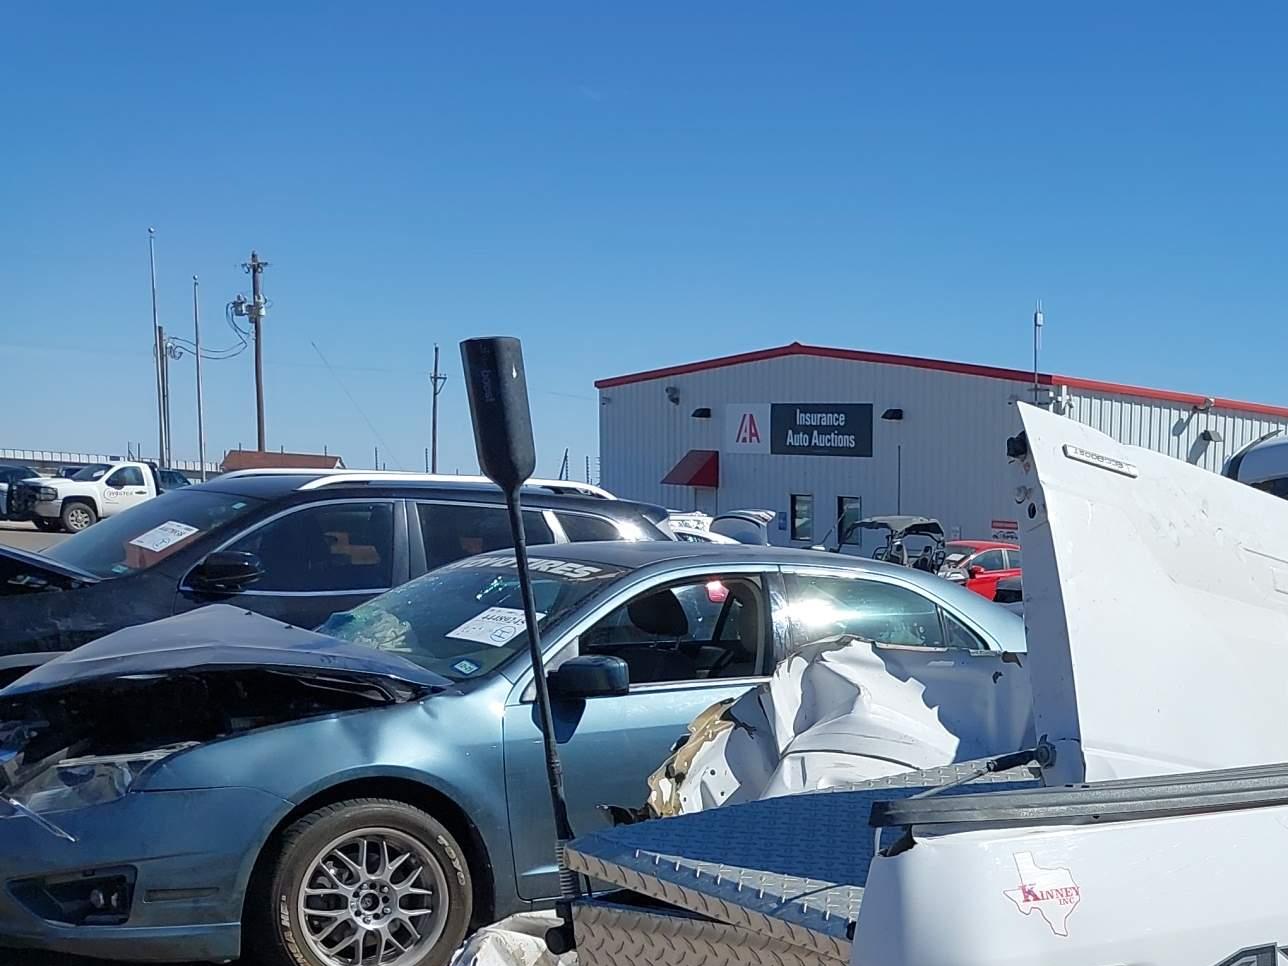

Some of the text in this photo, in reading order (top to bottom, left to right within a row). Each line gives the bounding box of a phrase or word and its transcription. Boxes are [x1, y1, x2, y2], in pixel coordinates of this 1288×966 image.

[796, 408, 845, 426] Insurance
[786, 429, 856, 448] Auto Auctions
[436, 834, 466, 886] TOYO
